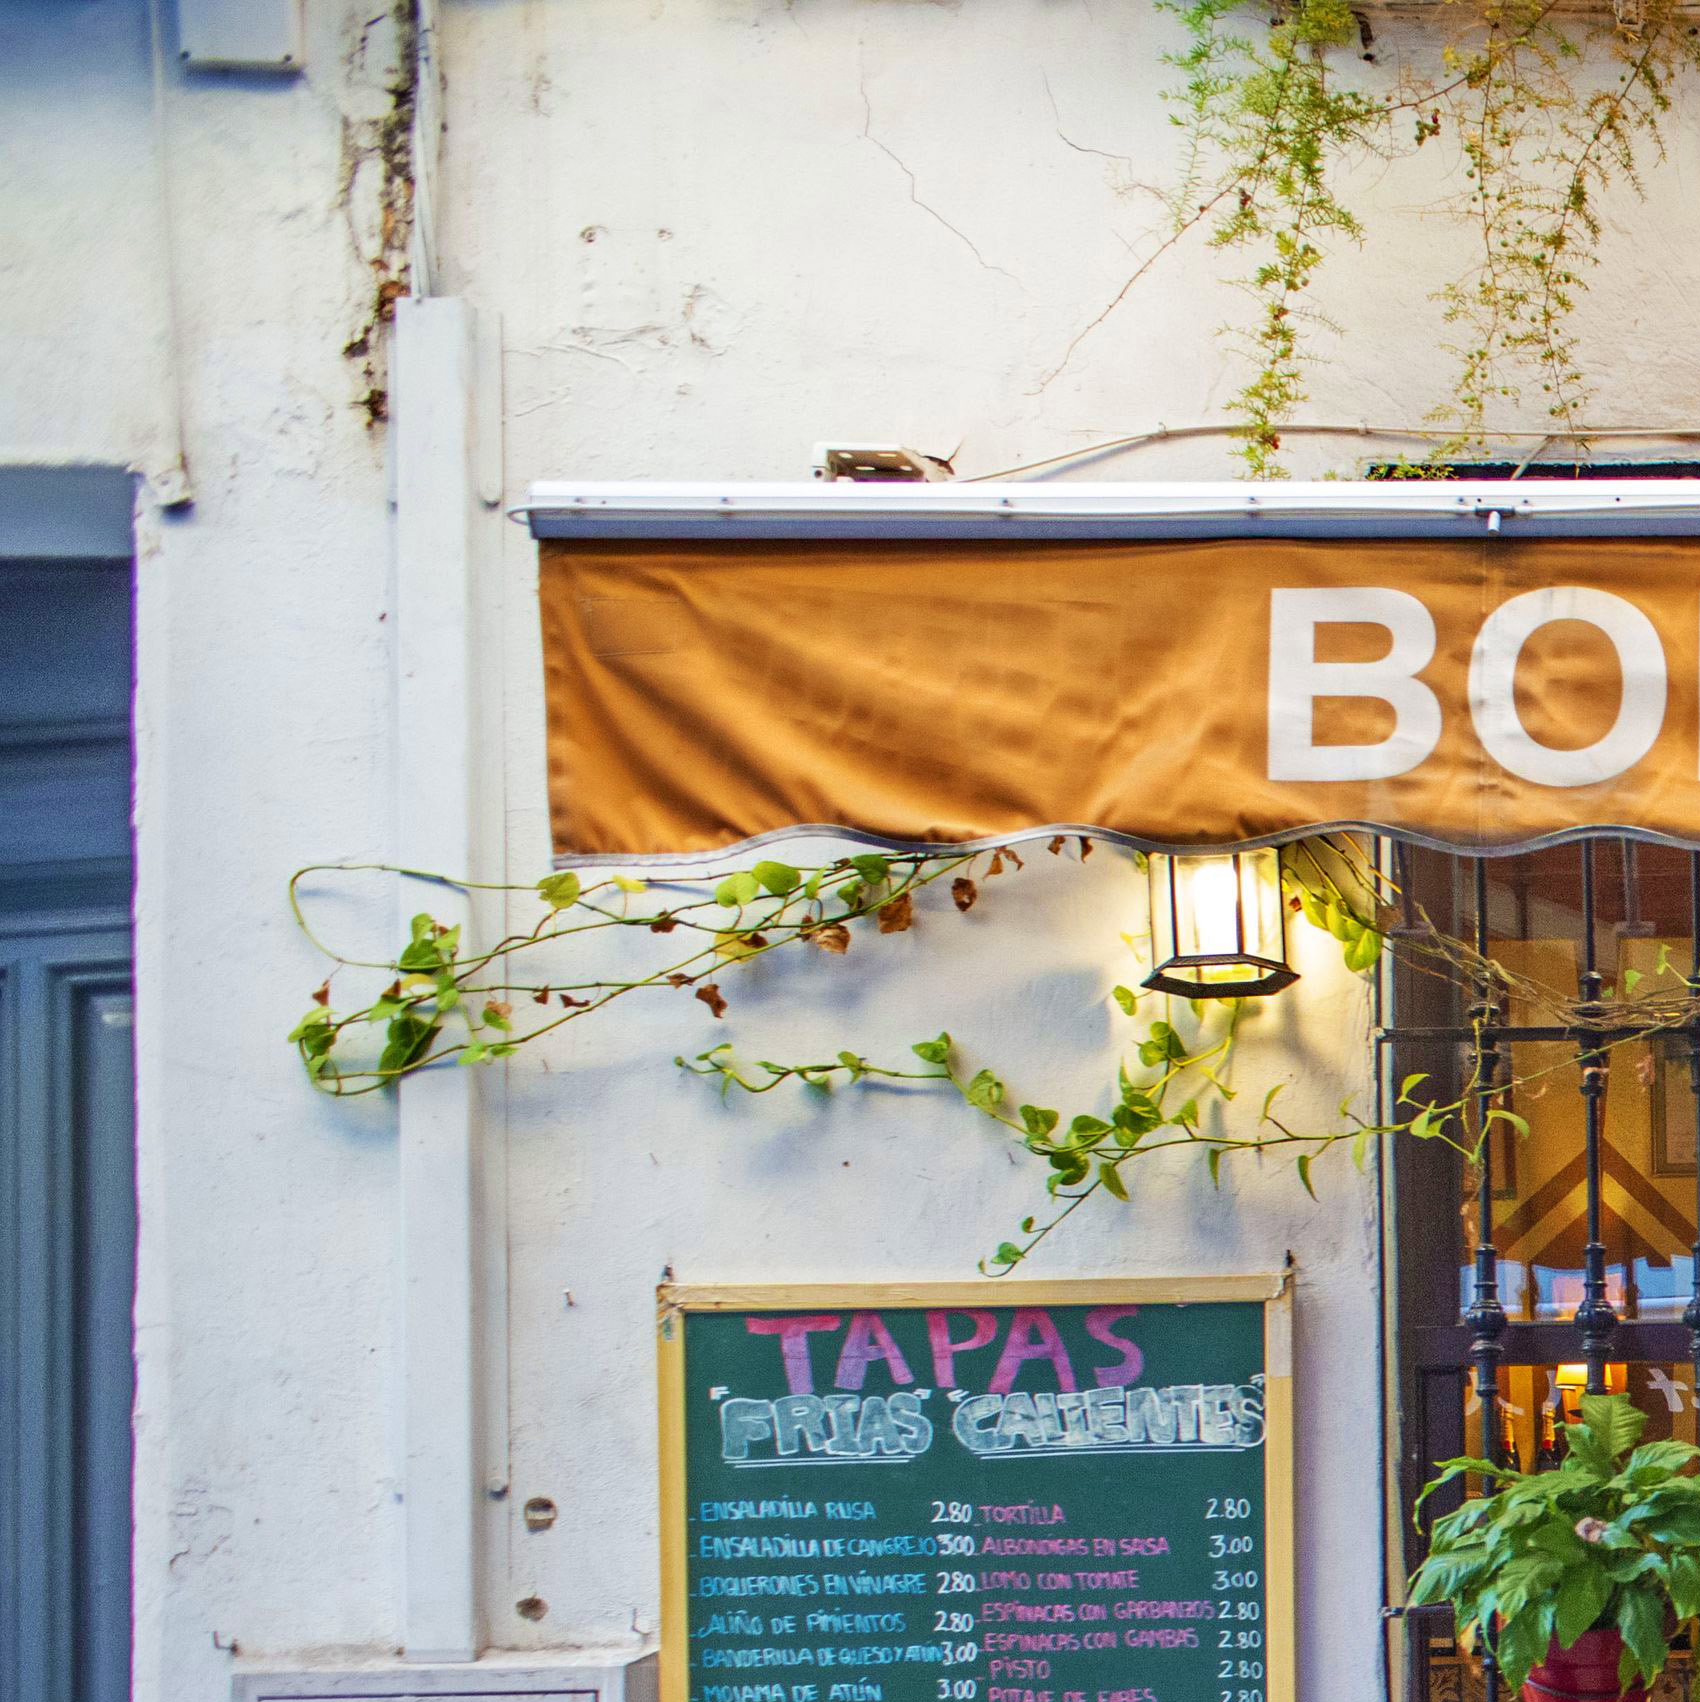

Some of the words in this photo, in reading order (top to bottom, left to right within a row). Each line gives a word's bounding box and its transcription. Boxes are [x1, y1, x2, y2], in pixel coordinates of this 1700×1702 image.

[746, 1307, 1145, 1394] TAPAS
[825, 1502, 877, 1520] RUSA
[1205, 1498, 1250, 1520] 2.80
[823, 1538, 845, 1557] DE
[848, 1536, 937, 1556] CANGREJO
[1093, 1538, 1115, 1556] EN
[1119, 1537, 1170, 1556] SALSA
[1209, 1534, 1253, 1558] 3.00
[980, 1571, 1031, 1591] LOMO
[1037, 1573, 1072, 1589] CON
[1075, 1570, 1139, 1590] TOMATE
[1078, 1604, 1107, 1620] CON
[1218, 1601, 1259, 1620] 2.80
[771, 1616, 795, 1634] DE
[1083, 1631, 1117, 1650] CON
[1124, 1627, 1199, 1648] GAMBAS
[1218, 1630, 1261, 1648] 2.80
[1218, 1660, 1263, 1679] 2.80
